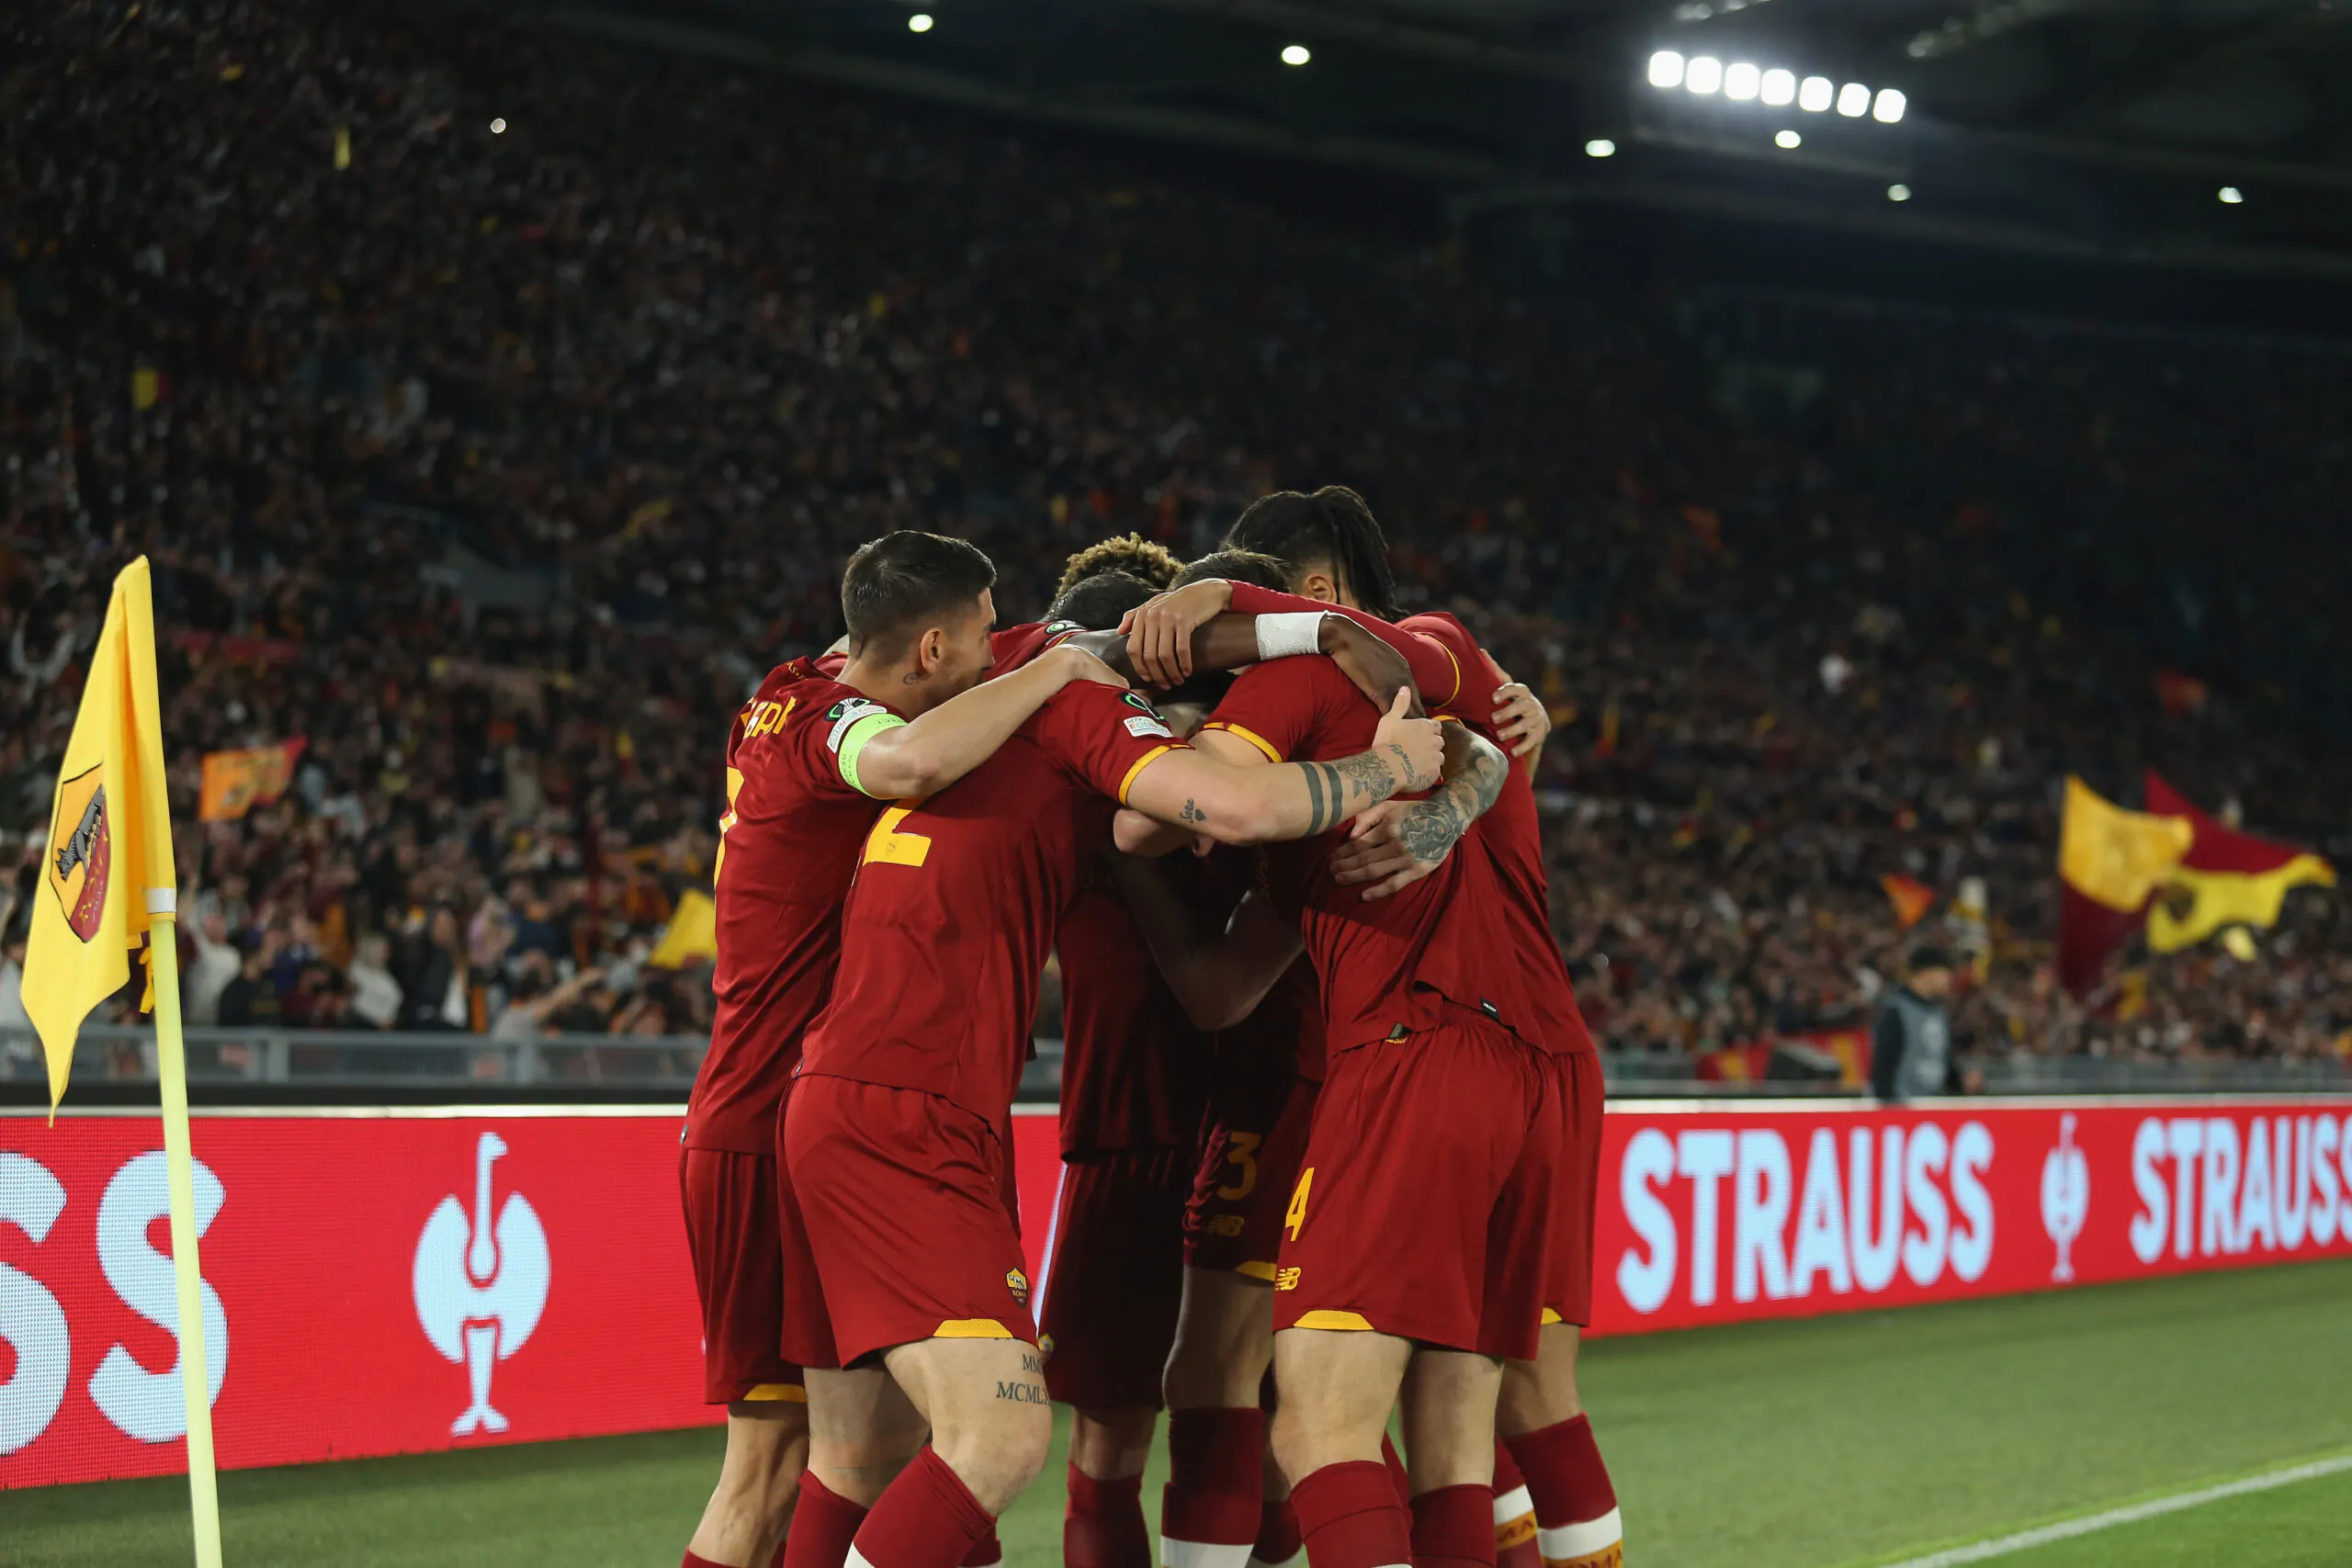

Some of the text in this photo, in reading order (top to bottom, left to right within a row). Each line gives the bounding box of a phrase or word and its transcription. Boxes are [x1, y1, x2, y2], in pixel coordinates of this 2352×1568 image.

[1217, 1131, 1261, 1201] 3
[1285, 1167, 1315, 1242] 4
[1616, 1120, 1995, 1314] STRAUSS
